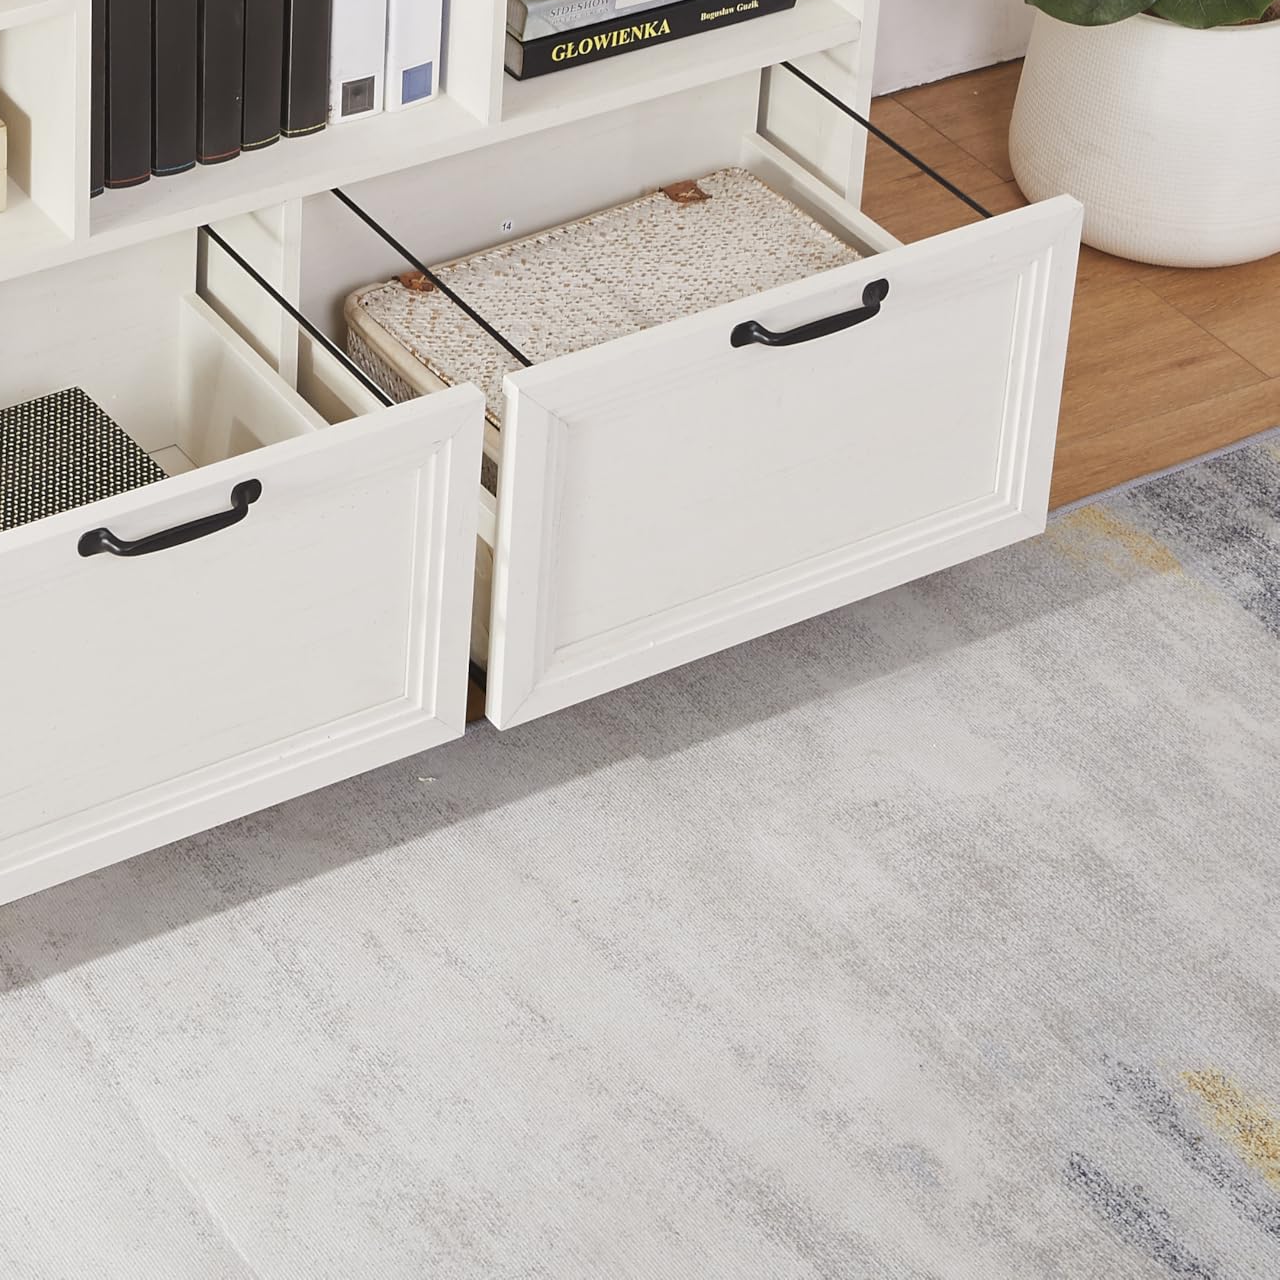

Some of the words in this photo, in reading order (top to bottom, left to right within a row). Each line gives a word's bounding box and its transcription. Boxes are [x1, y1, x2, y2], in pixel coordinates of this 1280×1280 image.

[551, 18, 671, 63] GŁOWIENKA
[736, 0, 760, 13] Guzik
[502, 221, 512, 231] 14
